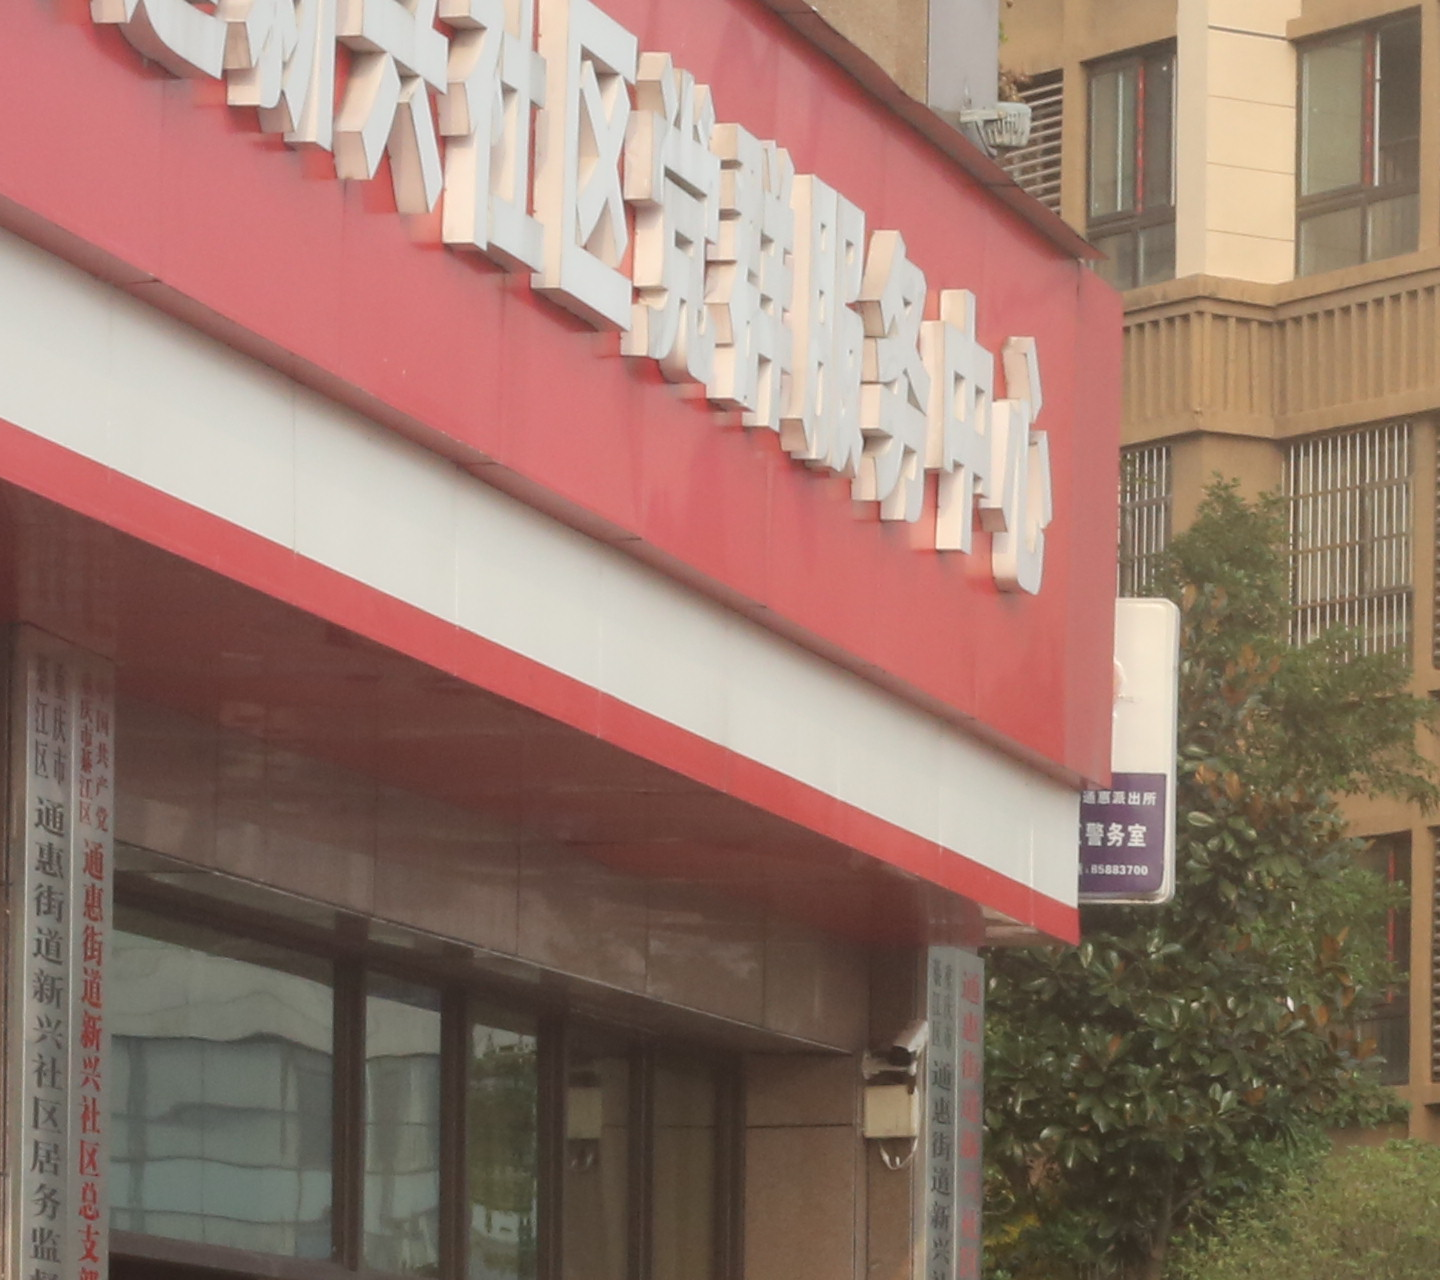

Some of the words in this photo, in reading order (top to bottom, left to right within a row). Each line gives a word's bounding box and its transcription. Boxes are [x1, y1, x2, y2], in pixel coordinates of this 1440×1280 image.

[91, 0, 1052, 595] 兴社区党群服务中心
[1079, 790, 1157, 807] 通惠派出所
[1079, 820, 1147, 849] 警务室
